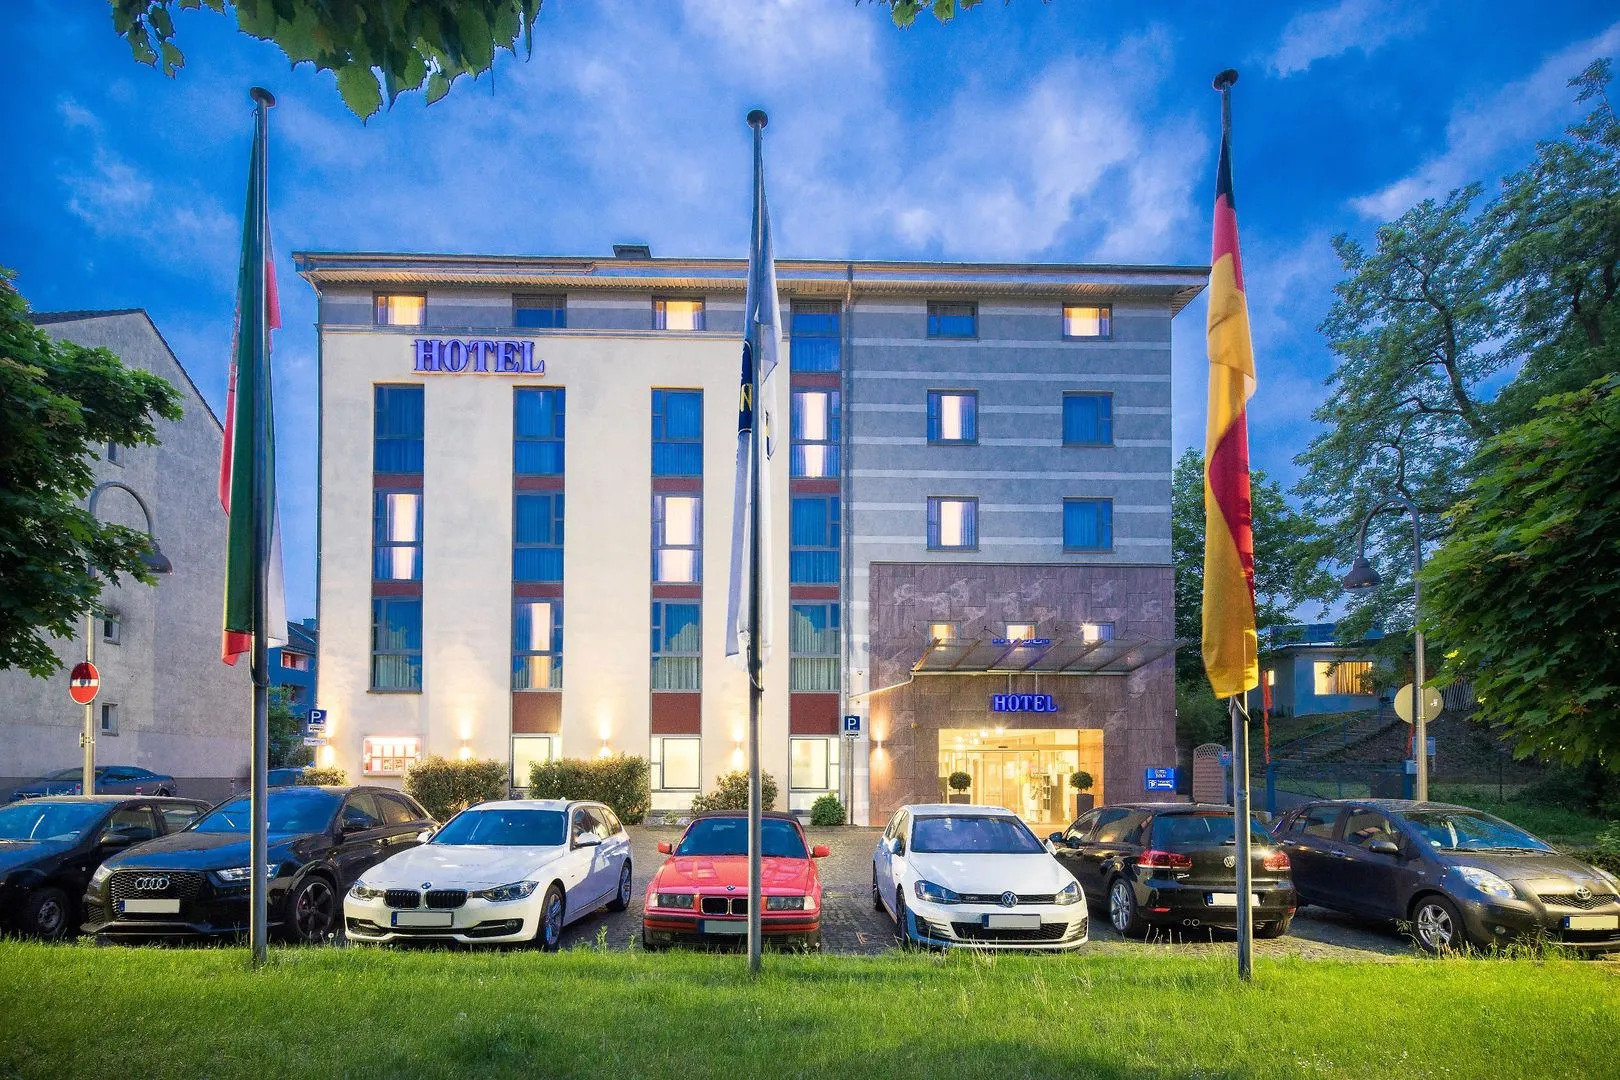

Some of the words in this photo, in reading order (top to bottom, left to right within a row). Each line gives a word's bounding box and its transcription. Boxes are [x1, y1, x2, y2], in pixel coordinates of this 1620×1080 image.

[414, 339, 545, 373] HOTEL
[993, 694, 1058, 713] HOTEL
[311, 710, 322, 723] P
[848, 717, 857, 730] P
